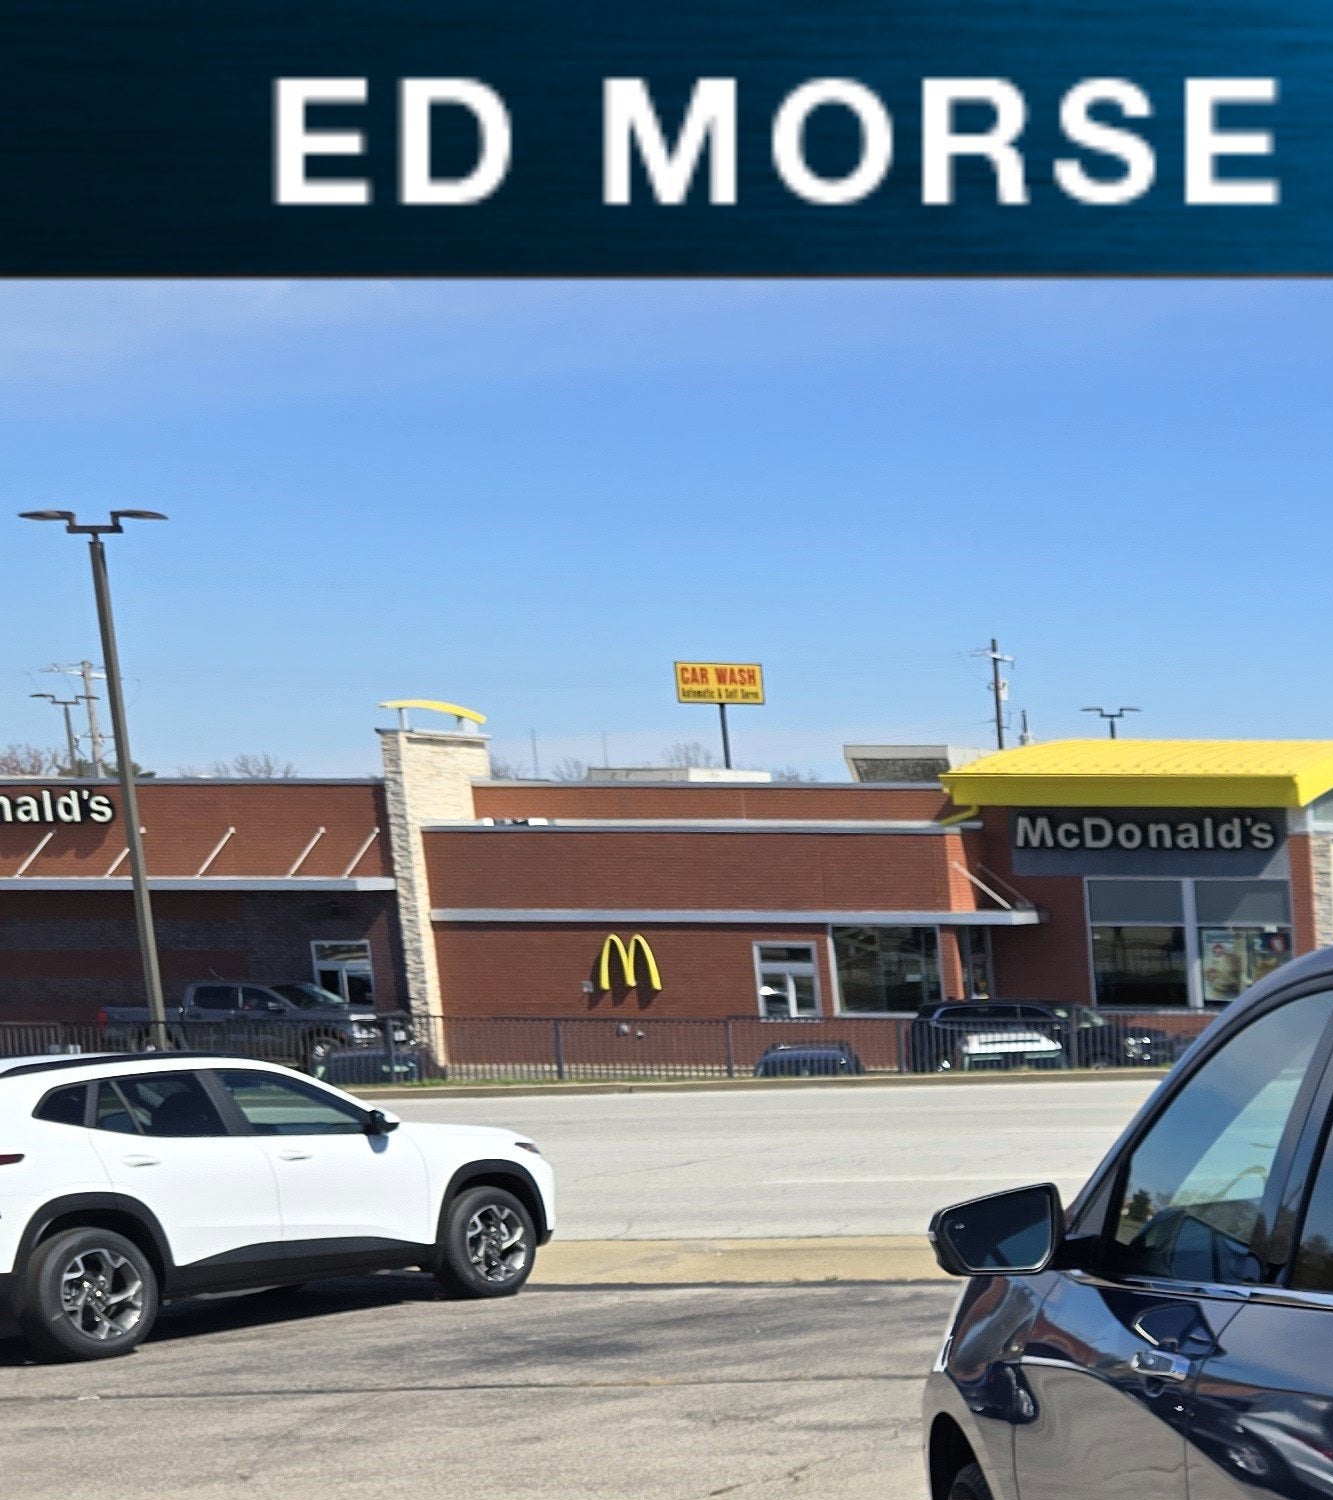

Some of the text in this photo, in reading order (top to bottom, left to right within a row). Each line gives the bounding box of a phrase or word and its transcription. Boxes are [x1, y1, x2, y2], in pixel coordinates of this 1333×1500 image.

[681, 667, 756, 686] CAR WASH
[1016, 816, 1275, 849] McDonald's
